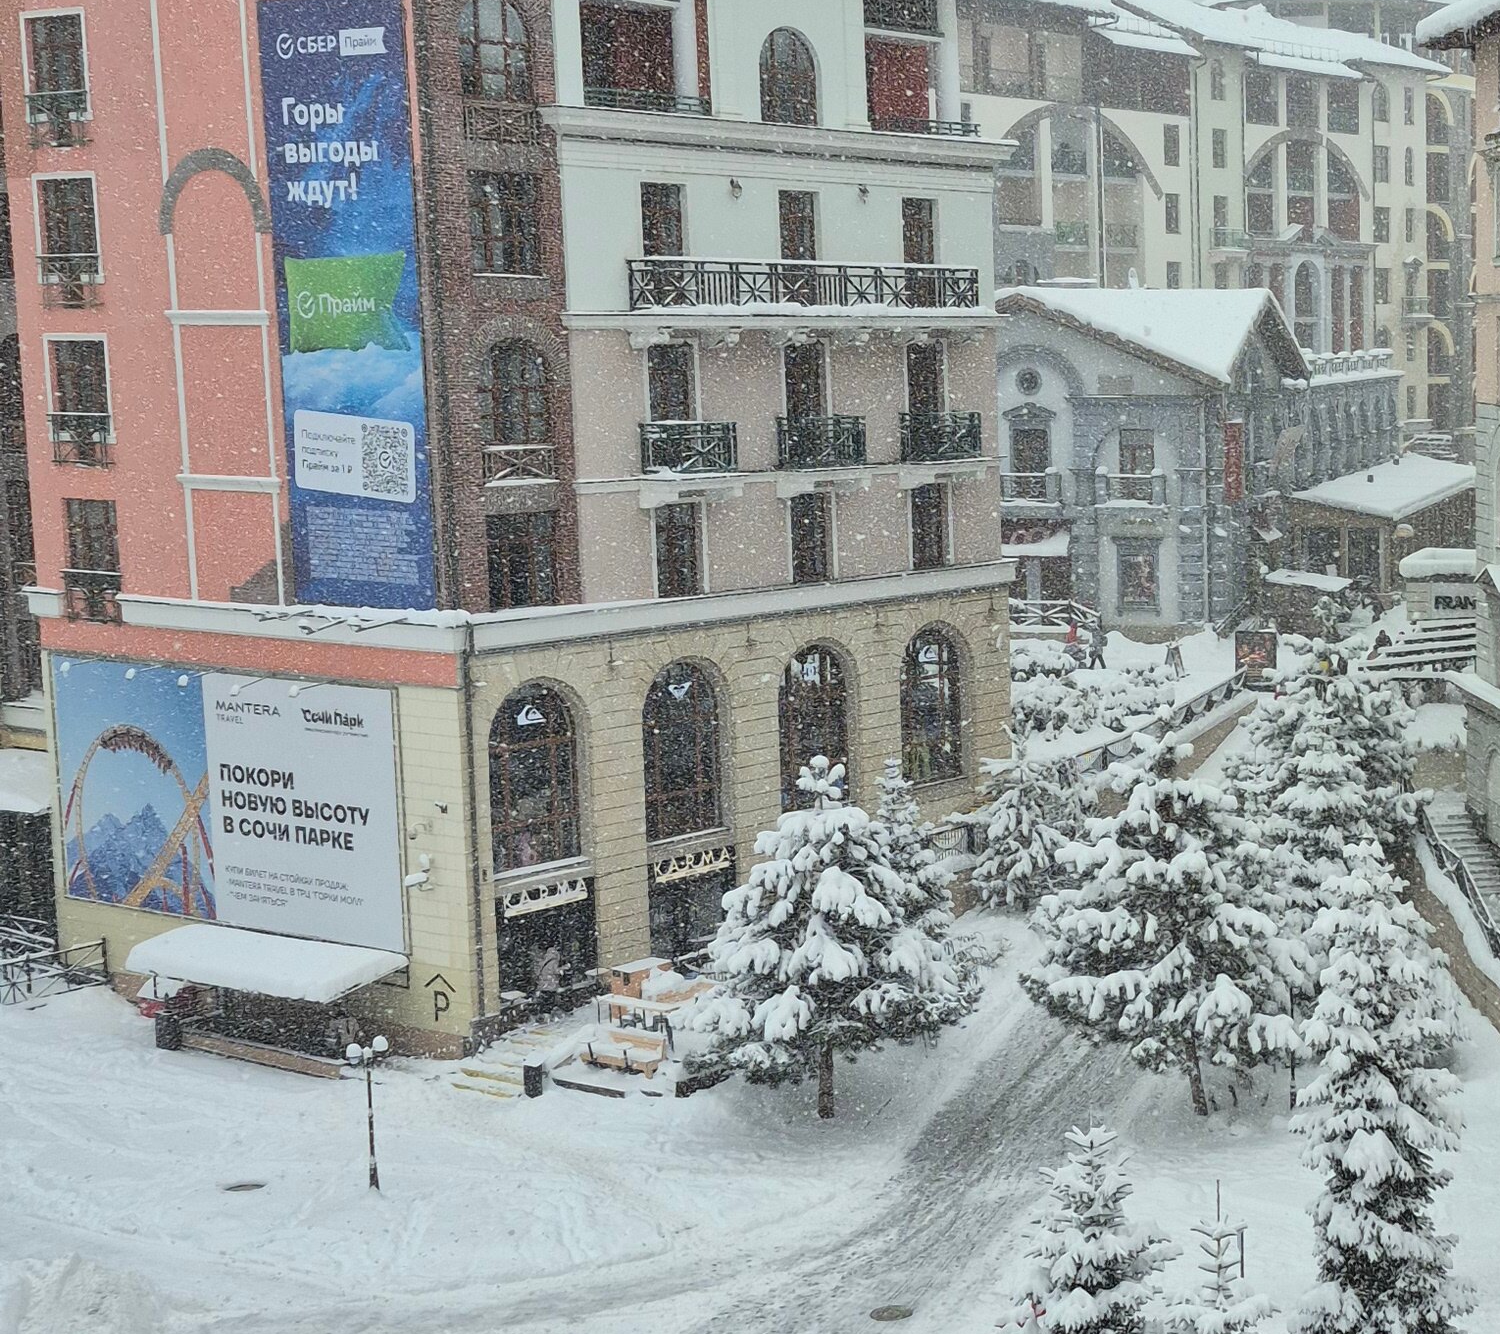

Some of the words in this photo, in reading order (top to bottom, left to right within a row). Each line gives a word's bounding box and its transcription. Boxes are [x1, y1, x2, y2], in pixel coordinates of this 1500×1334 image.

[296, 35, 337, 54] СБЕР
[344, 35, 378, 49] Прайм
[281, 97, 344, 132] Горы
[284, 141, 380, 167] выгоды
[286, 172, 358, 209] ждут!
[318, 291, 376, 317] Прайм
[215, 700, 281, 717] MANTERA
[216, 713, 244, 724] TRAVEL
[301, 708, 332, 725] Сочи
[333, 710, 364, 729] Парк
[219, 763, 295, 790] ПОКОРИ
[221, 789, 287, 816] НОВУЮ
[292, 799, 370, 826] ВЫСОТУ
[223, 815, 235, 834] В
[238, 818, 291, 842] СОЧИ
[294, 826, 355, 851] ПАРКЕ
[244, 867, 267, 879] БИЛЕТ
[268, 871, 279, 880] НА
[656, 846, 730, 880] KARMA
[262, 883, 289, 895] TRAVEL
[503, 877, 588, 911] KARMA
[434, 990, 450, 1022] P
